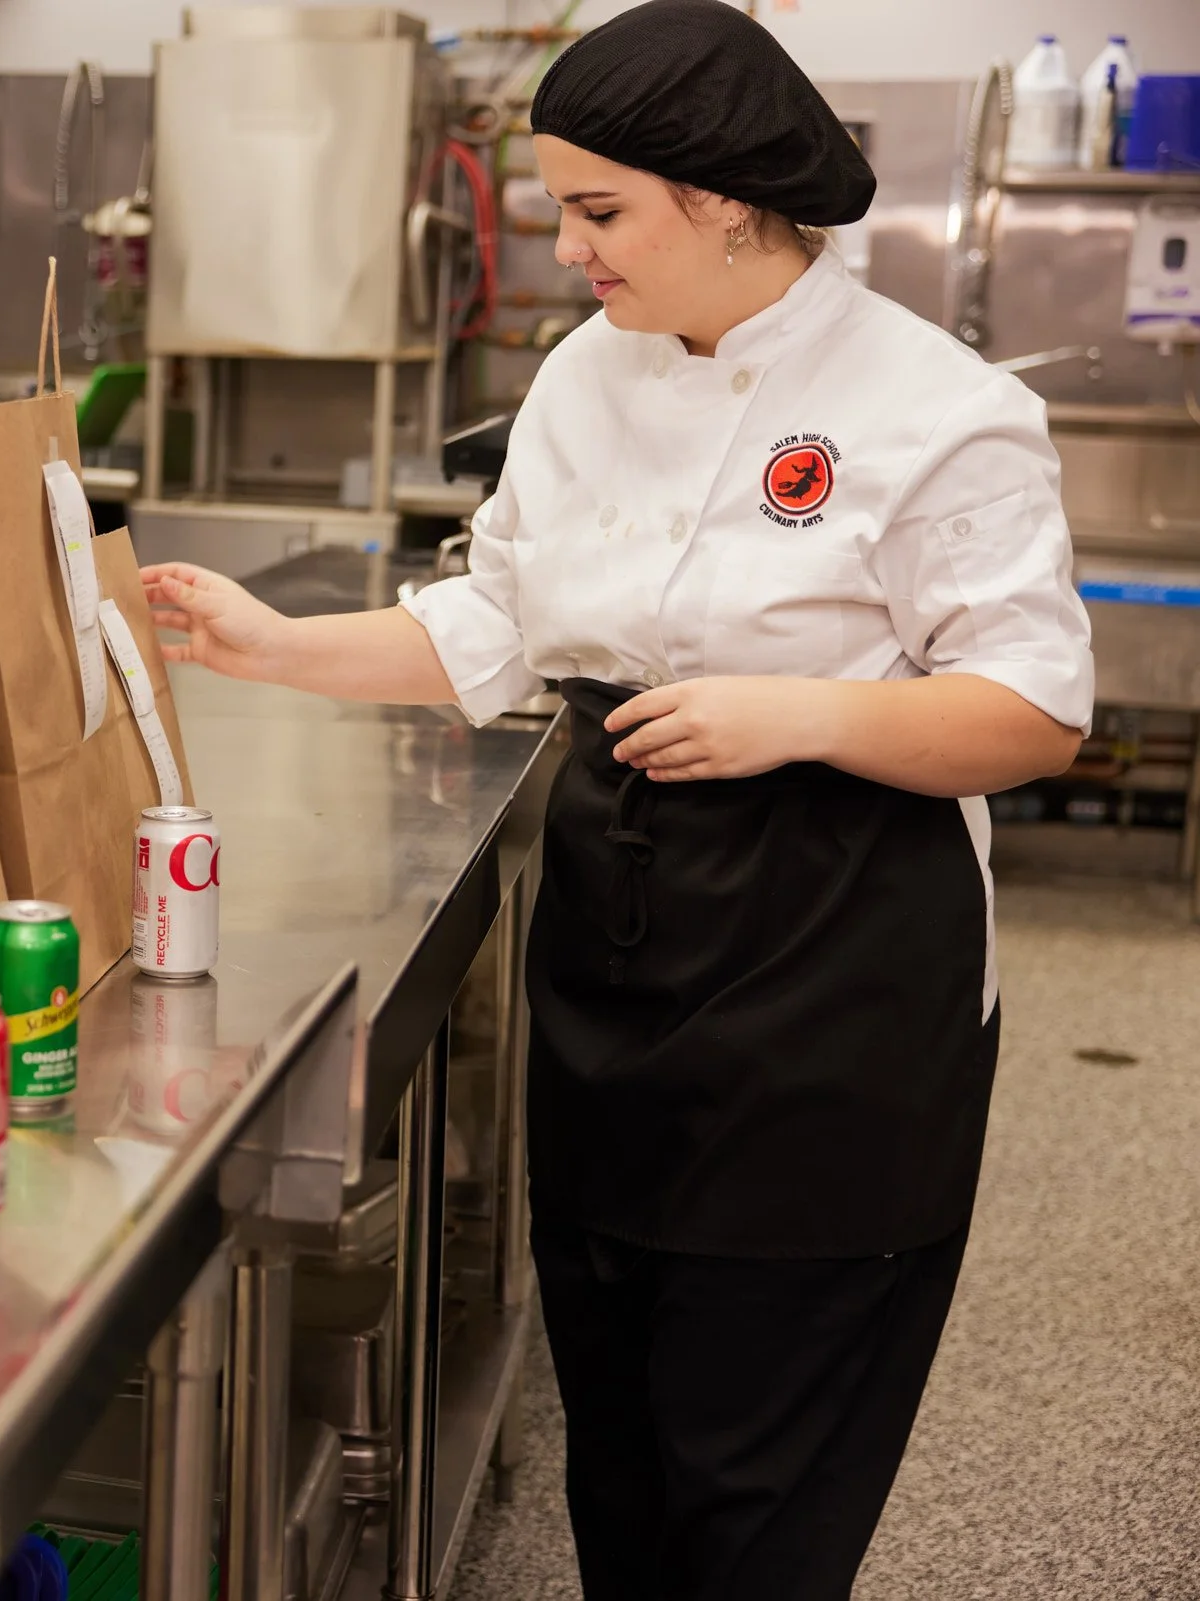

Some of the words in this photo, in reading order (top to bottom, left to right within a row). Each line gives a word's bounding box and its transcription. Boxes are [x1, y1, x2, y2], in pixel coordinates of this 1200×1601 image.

[770, 435, 799, 452] SALEM
[802, 432, 821, 443] HIGH
[821, 436, 842, 464] SCHOOL
[759, 503, 798, 528] CULINARY
[802, 513, 824, 528] ARTS
[158, 895, 167, 912] ME
[157, 916, 167, 965] RECYCLE
[22, 1049, 68, 1064] GINGER
